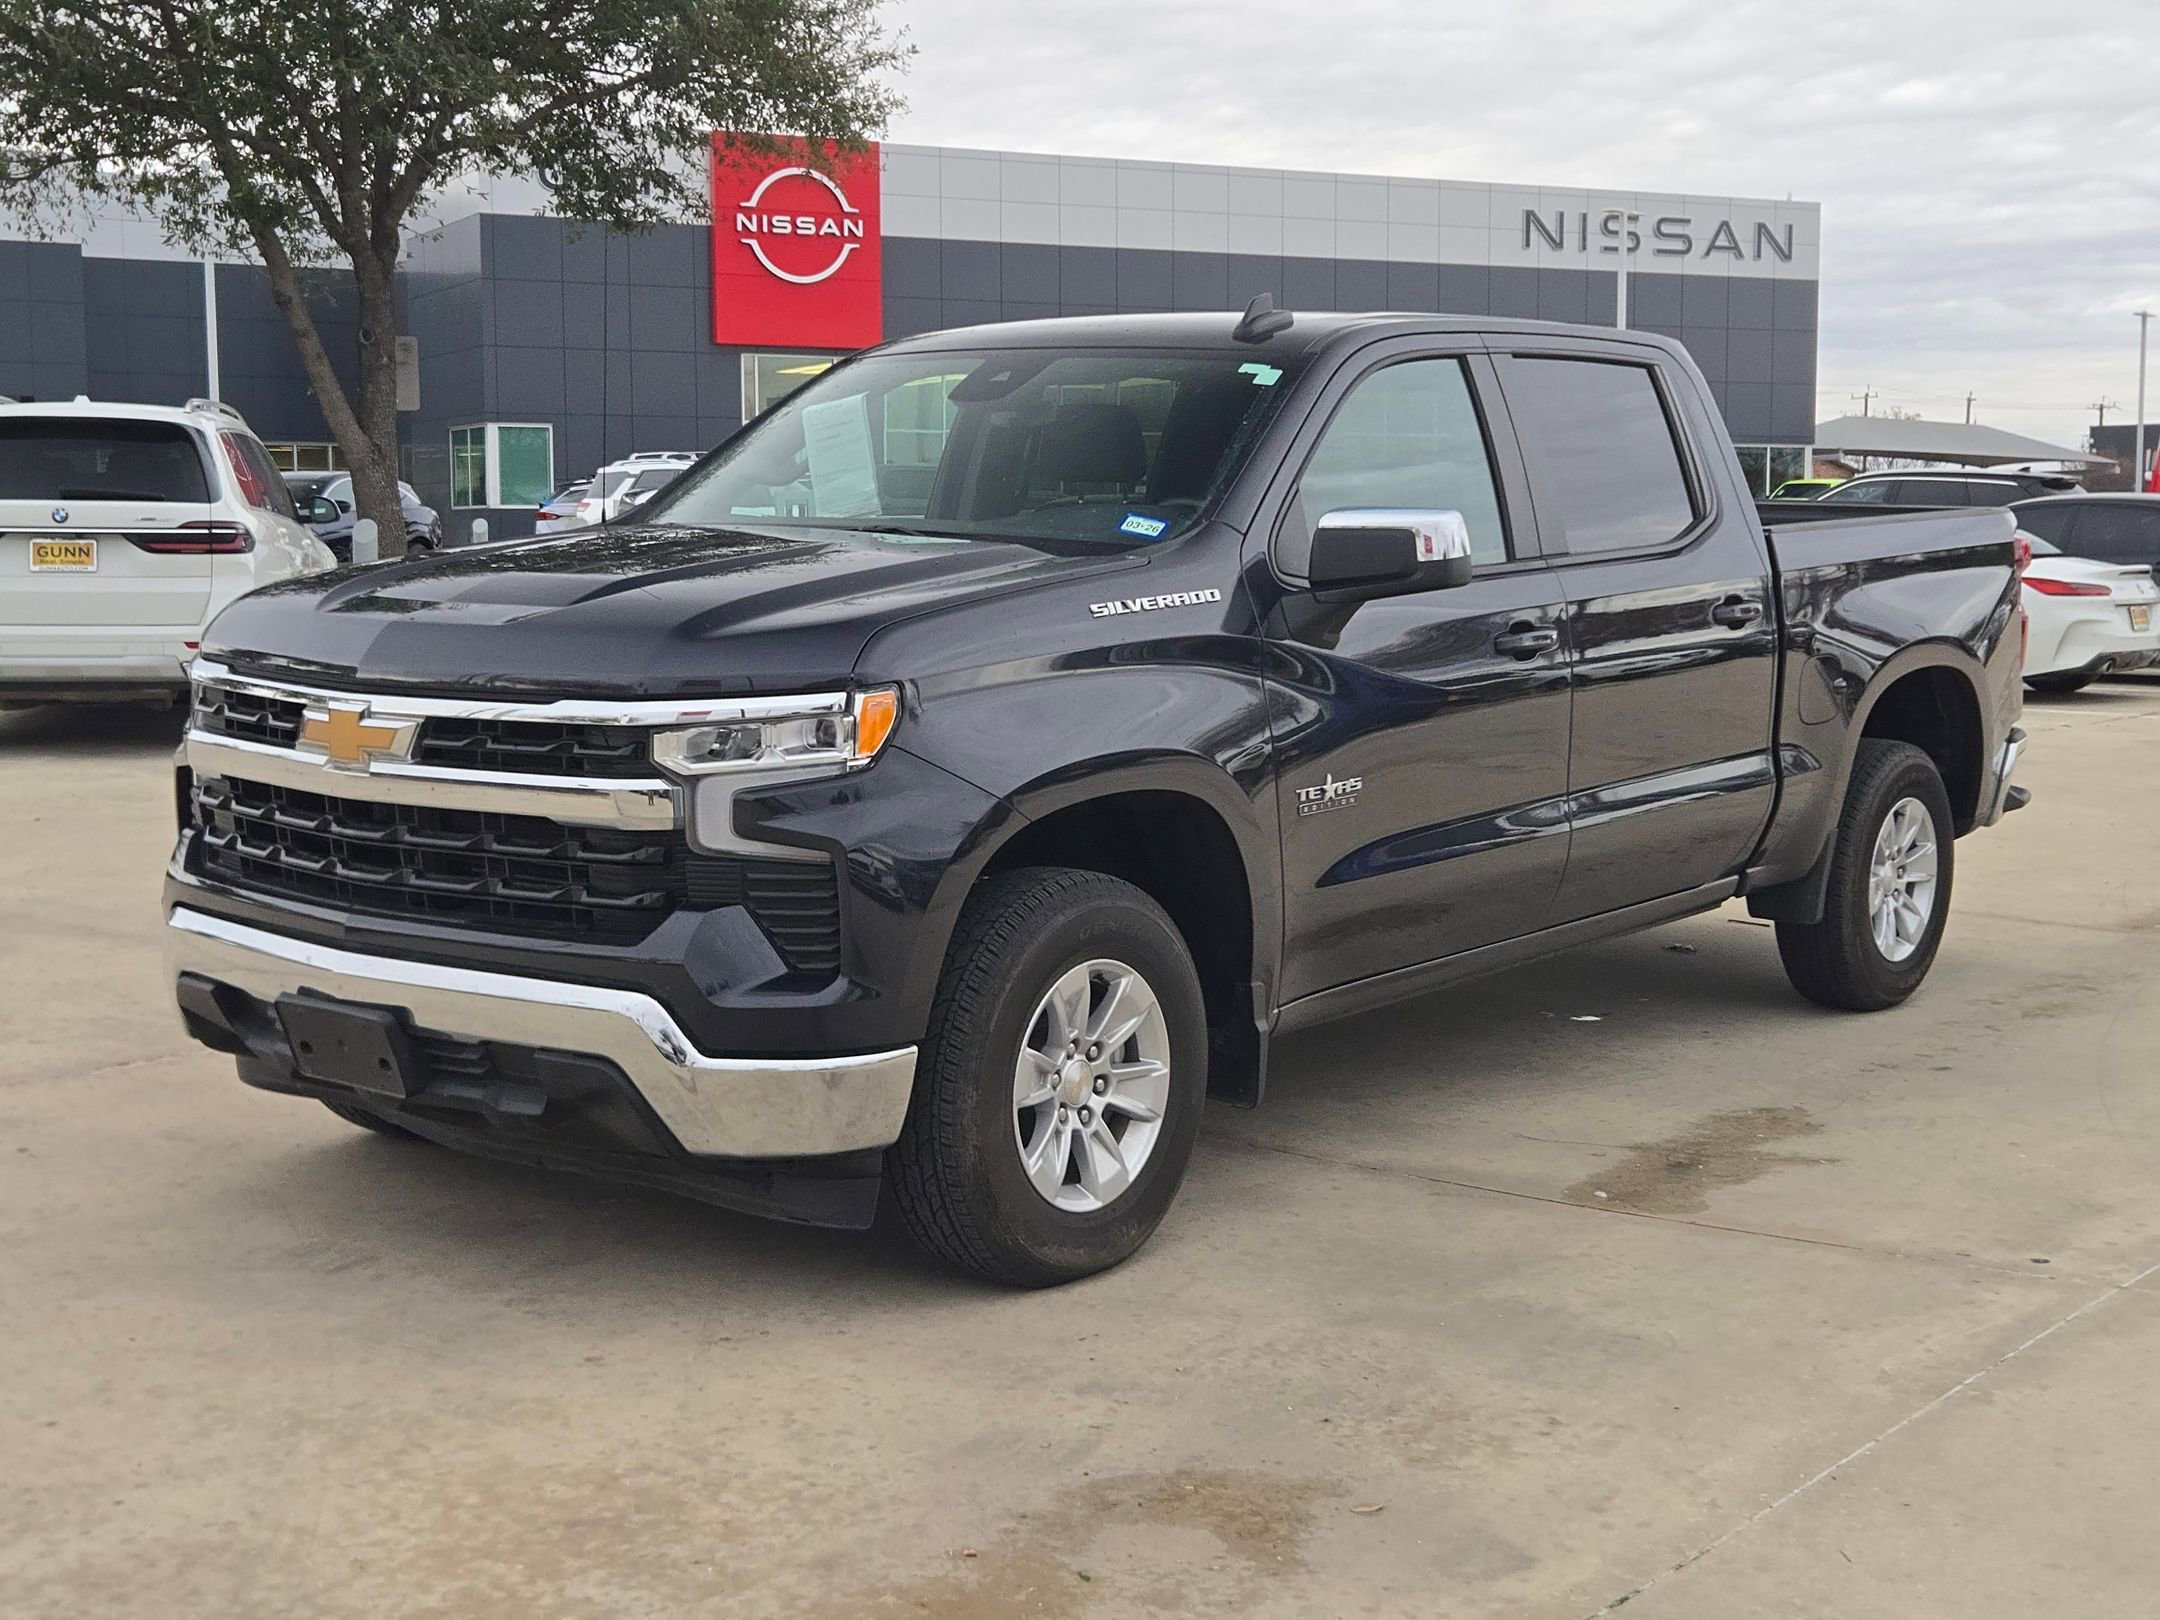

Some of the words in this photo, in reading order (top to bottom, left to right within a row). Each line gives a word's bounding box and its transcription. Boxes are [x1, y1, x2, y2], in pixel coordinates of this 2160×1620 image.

[736, 212, 864, 238] NISSAN
[1522, 208, 1794, 262] NISSAN
[36, 545, 90, 558] GUNN
[1088, 588, 1222, 618] SILVERADO
[1295, 773, 1363, 803] TEXAS
[1303, 797, 1355, 813] EDITION
